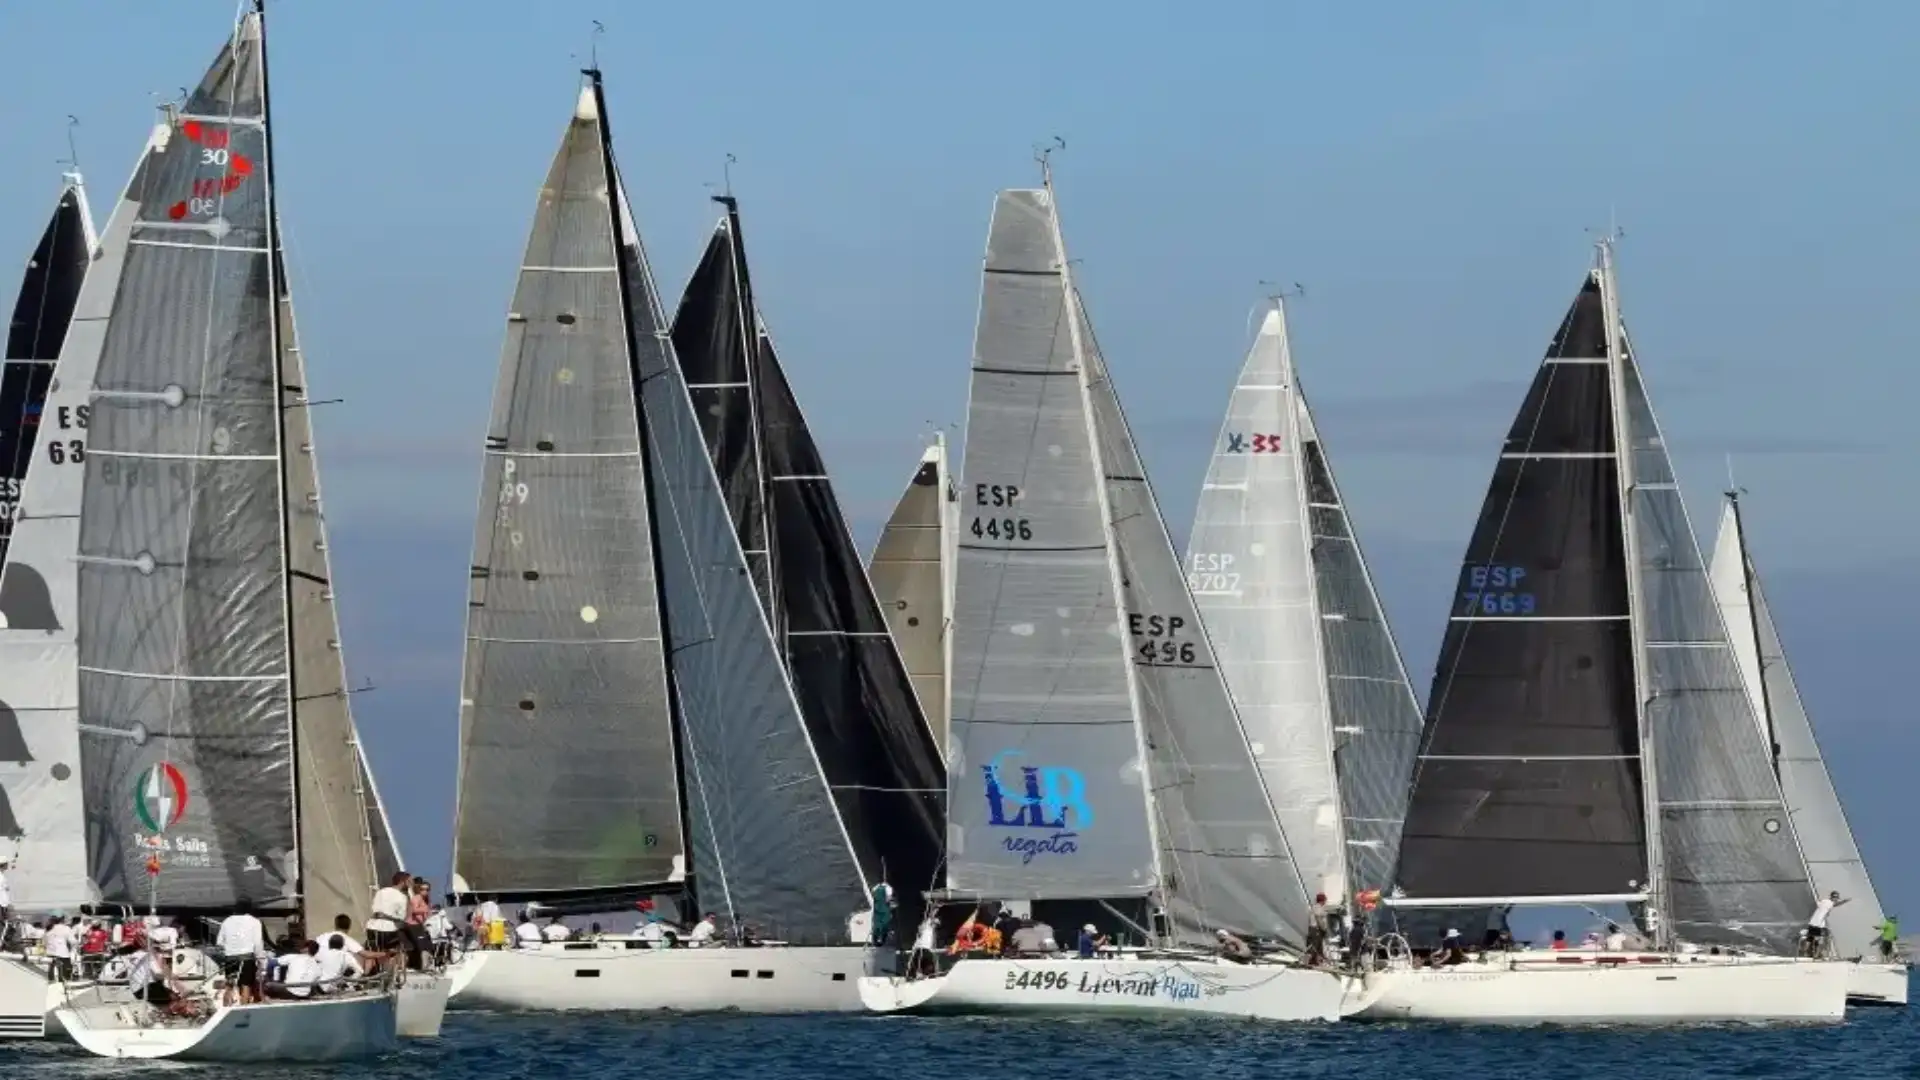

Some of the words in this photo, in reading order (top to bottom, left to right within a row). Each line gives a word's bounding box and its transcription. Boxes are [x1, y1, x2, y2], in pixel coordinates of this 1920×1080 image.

[201, 148, 229, 165] 30
[1227, 432, 1281, 454] X-35
[976, 484, 1019, 507] ESP
[971, 517, 1032, 541] 4496
[1193, 554, 1234, 571] ESP
[1470, 566, 1526, 588] ESP
[1129, 613, 1184, 637] ESP
[1002, 833, 1079, 864] regata
[1016, 971, 1068, 990] 4496
